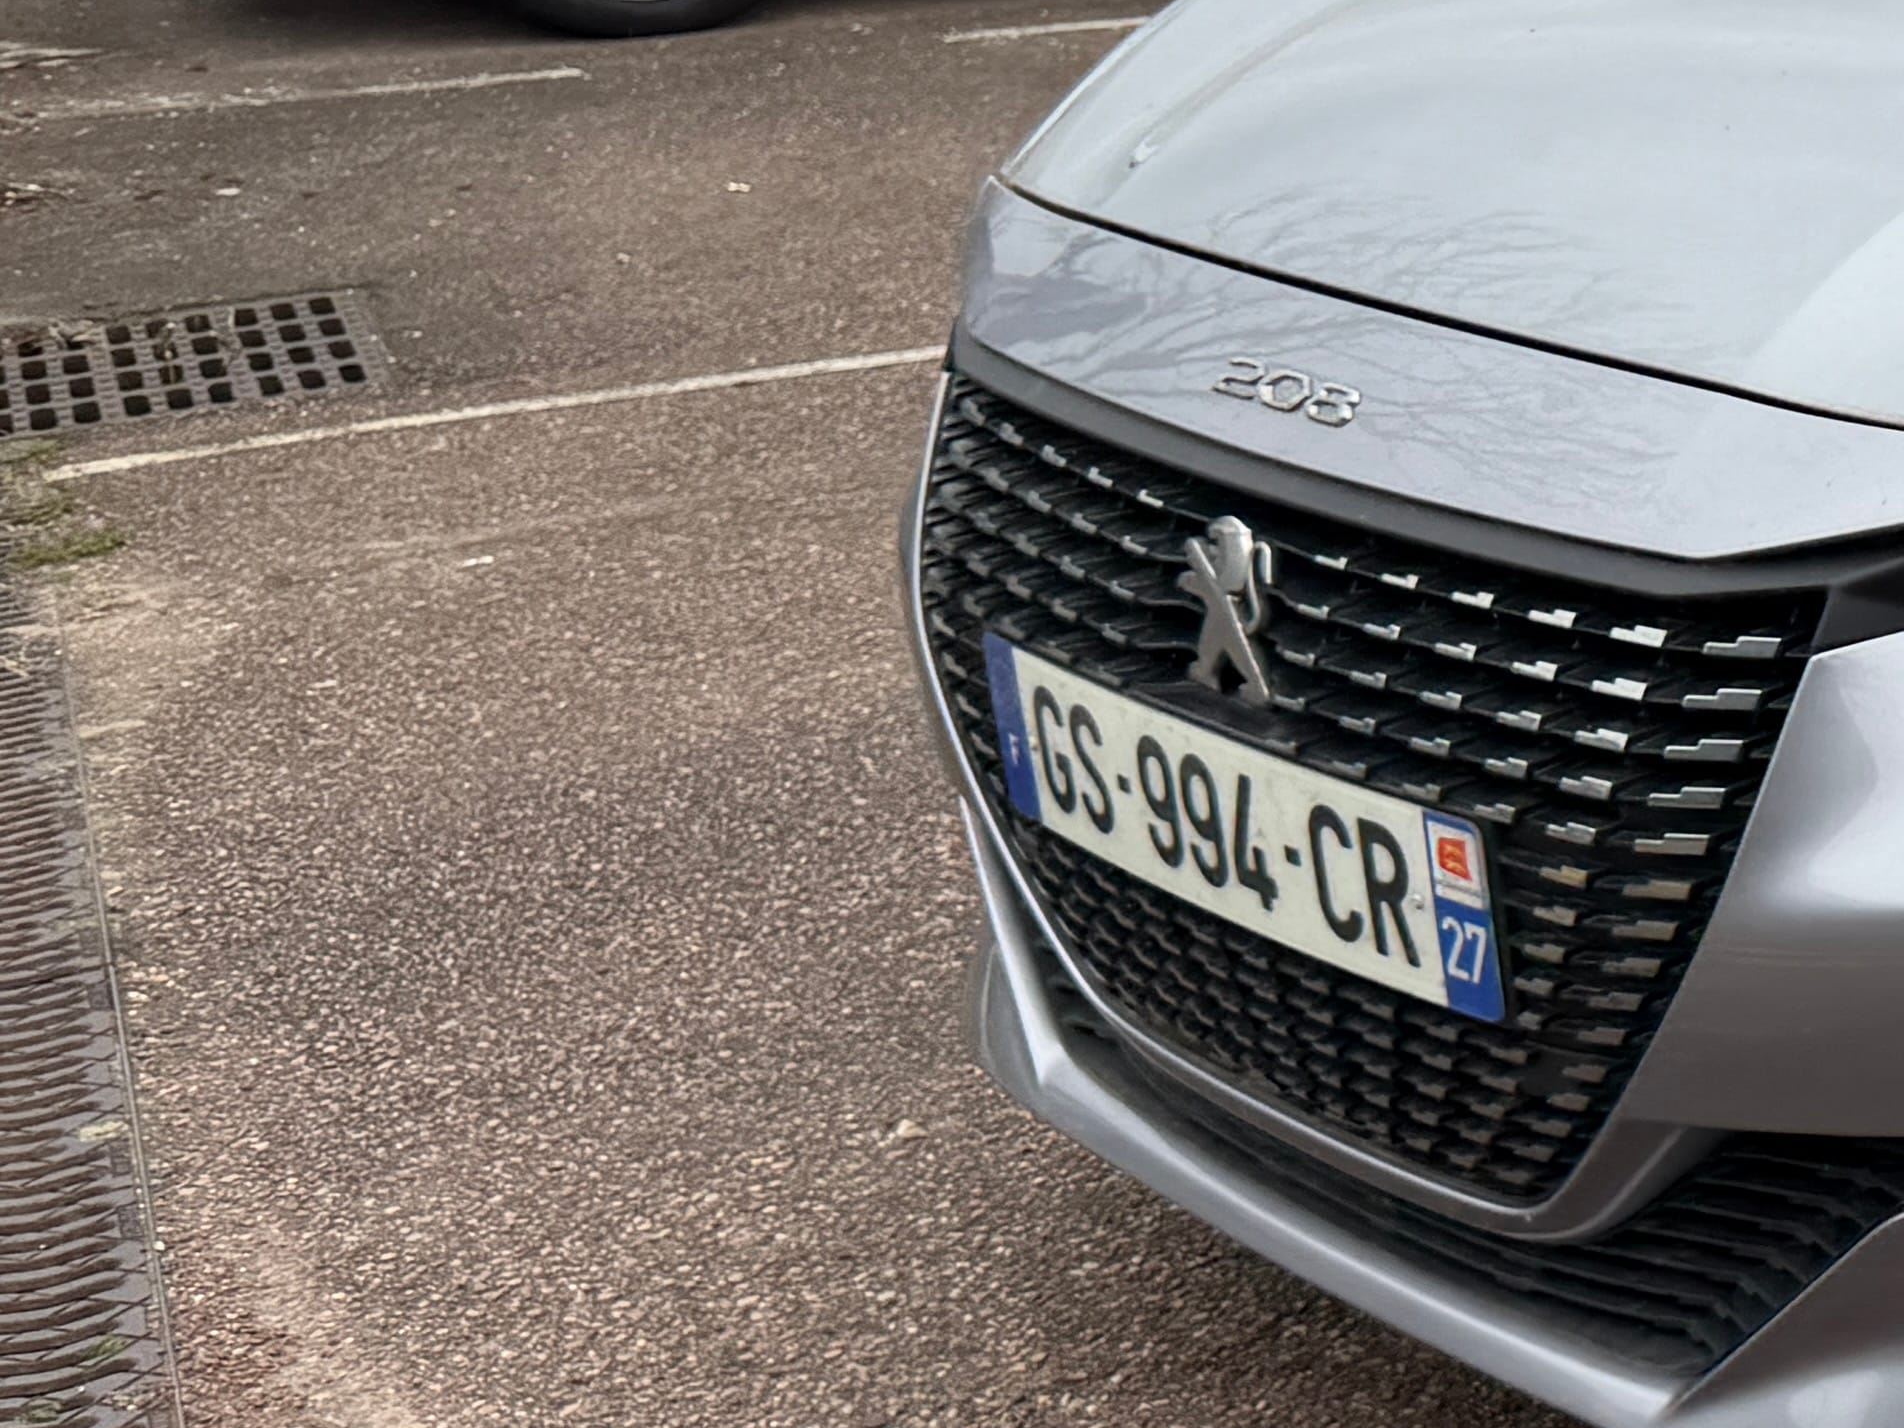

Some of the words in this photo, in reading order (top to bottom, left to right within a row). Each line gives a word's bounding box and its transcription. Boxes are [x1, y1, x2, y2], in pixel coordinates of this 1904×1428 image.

[1210, 356, 1362, 428] 208
[1032, 684, 1421, 969] GS-994-CR
[1441, 915, 1487, 985] 27
